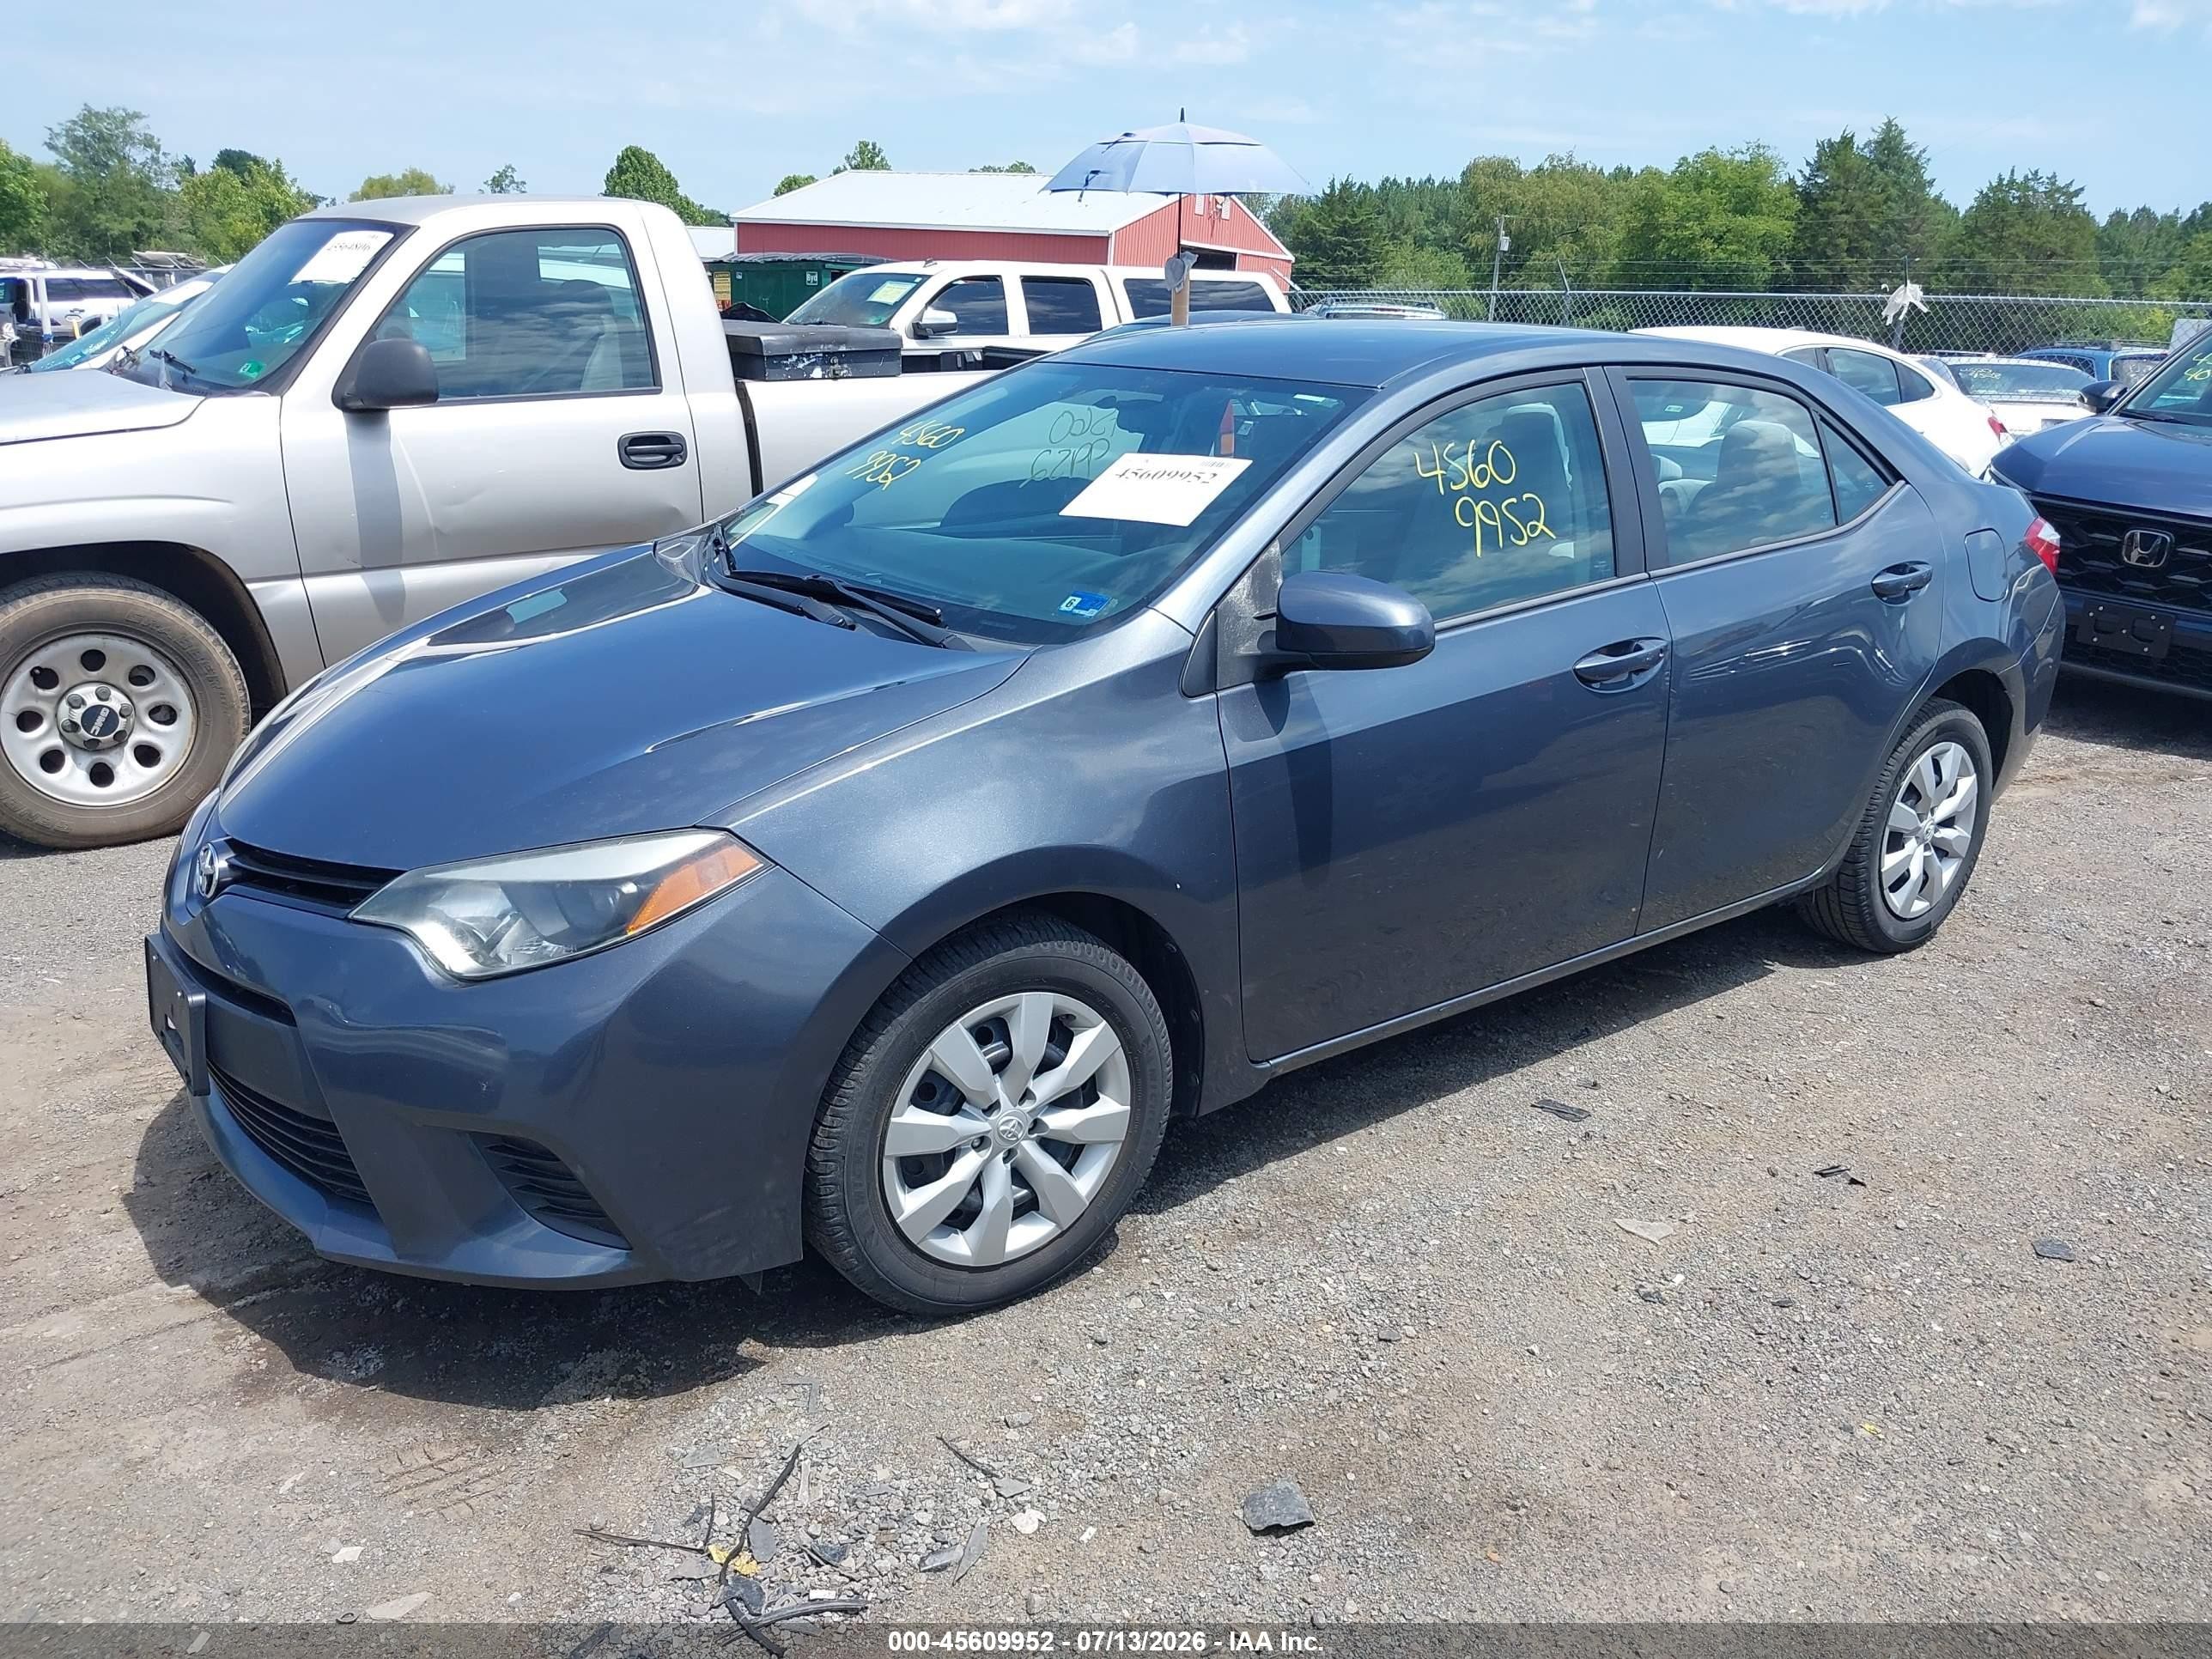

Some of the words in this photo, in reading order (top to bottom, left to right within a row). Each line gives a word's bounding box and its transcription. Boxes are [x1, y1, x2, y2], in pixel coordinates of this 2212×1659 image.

[891, 419, 965, 448] 4560
[845, 450, 921, 490] 9952
[1115, 467, 1218, 484] 45609952
[1413, 439, 1516, 495] 4560
[1455, 492, 1557, 558] 9952
[90, 707, 110, 736] GMC
